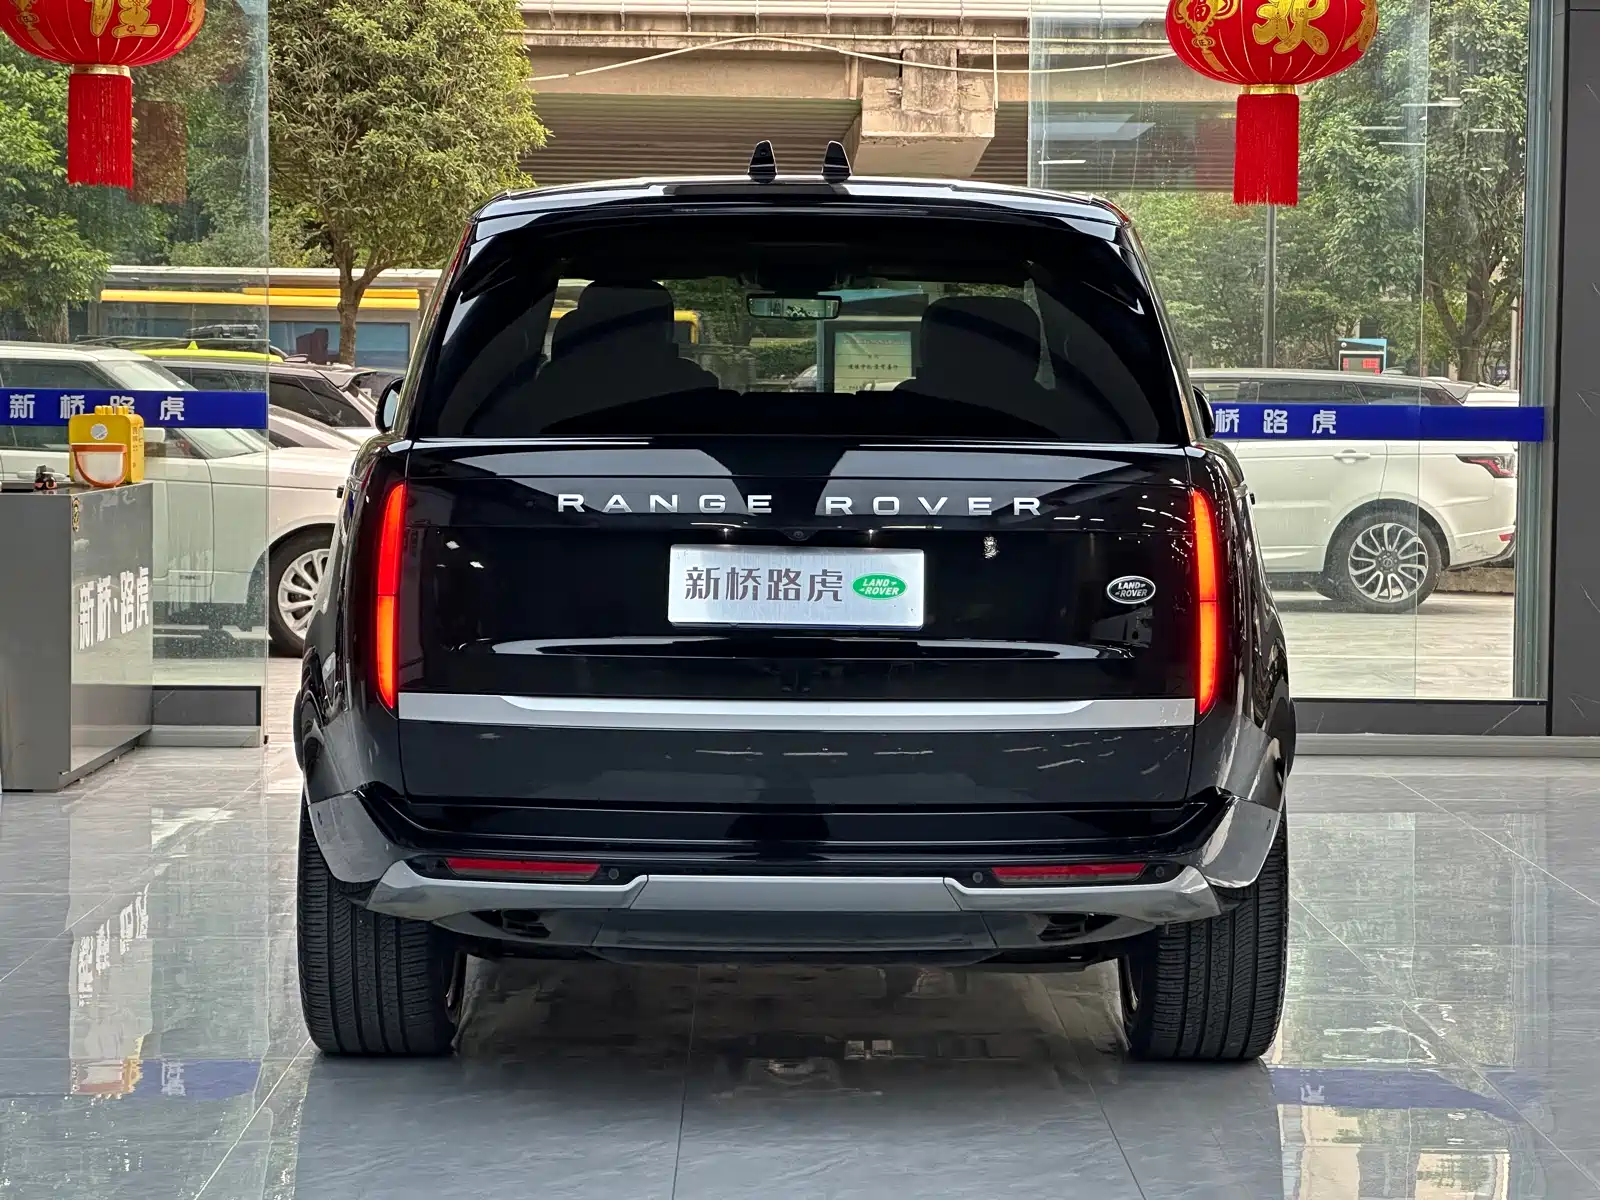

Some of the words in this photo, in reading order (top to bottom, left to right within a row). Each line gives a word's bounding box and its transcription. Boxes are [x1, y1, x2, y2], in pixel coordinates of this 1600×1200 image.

[557, 493, 773, 514] RANGE
[825, 496, 1041, 516] ROVER
[684, 566, 843, 602] 新桥路虎
[862, 578, 890, 587] LAND
[1118, 582, 1141, 590] LAND
[864, 587, 900, 596] ROVER
[1120, 589, 1148, 597] ROVER
